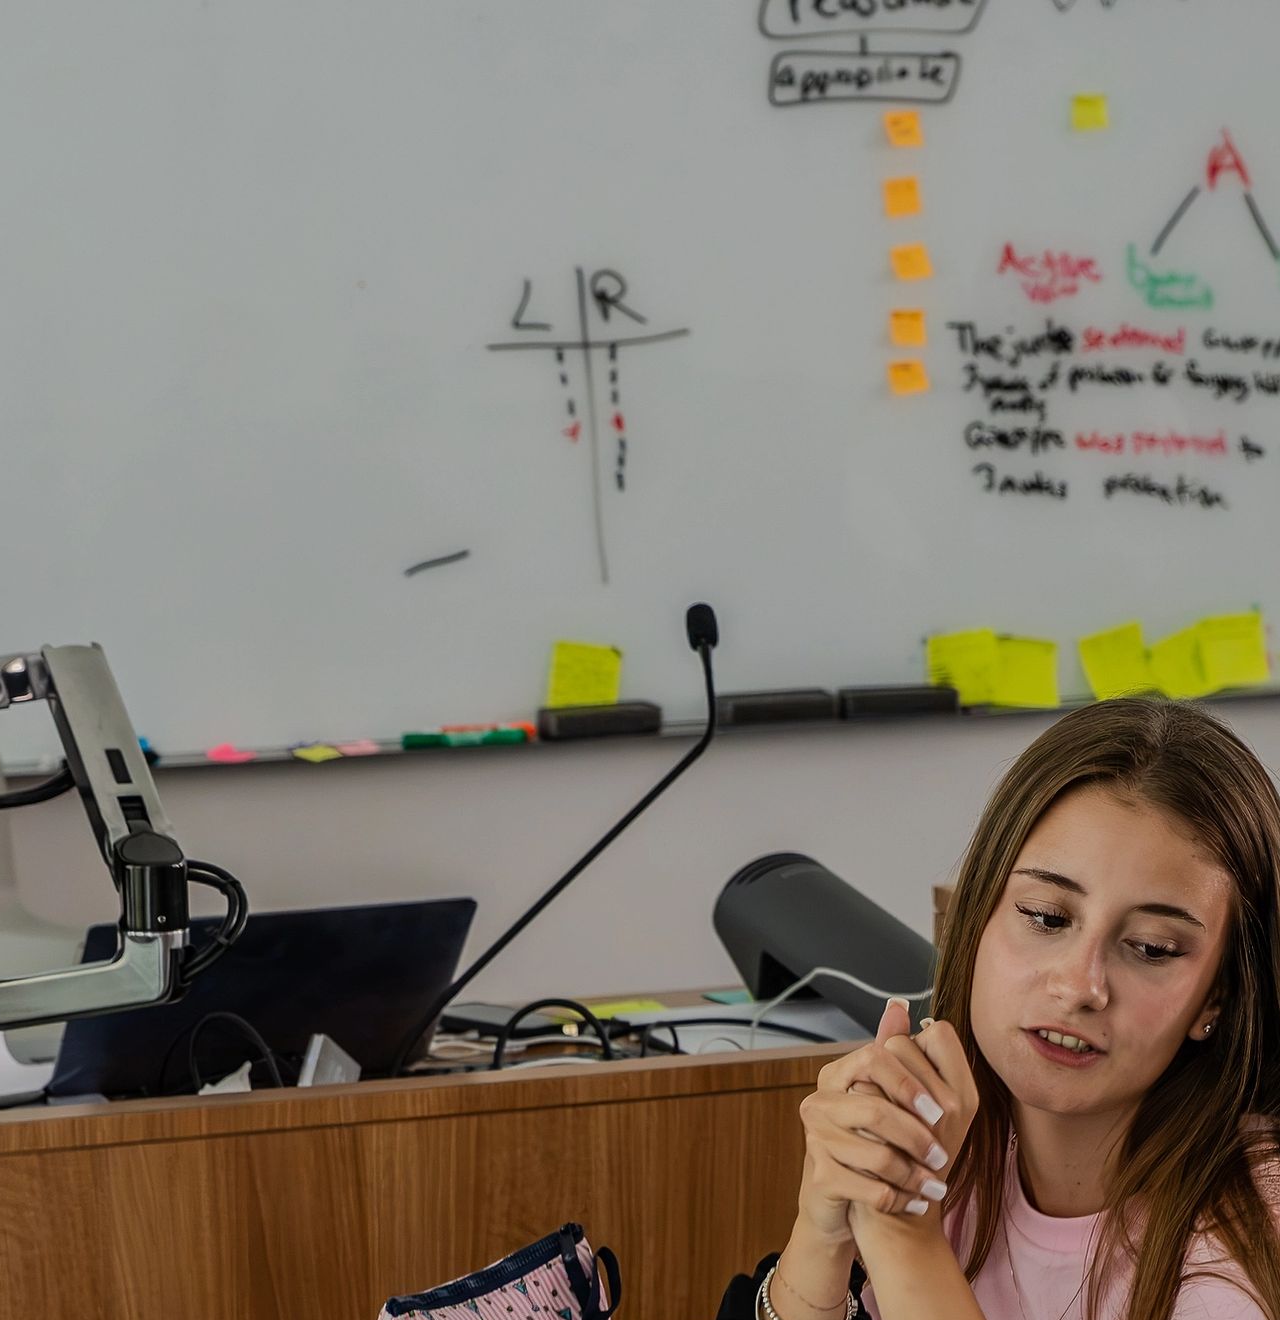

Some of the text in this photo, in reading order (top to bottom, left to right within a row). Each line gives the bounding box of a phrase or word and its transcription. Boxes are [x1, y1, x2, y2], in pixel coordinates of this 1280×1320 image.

[1204, 127, 1252, 191] A
[511, 268, 647, 331] L R
